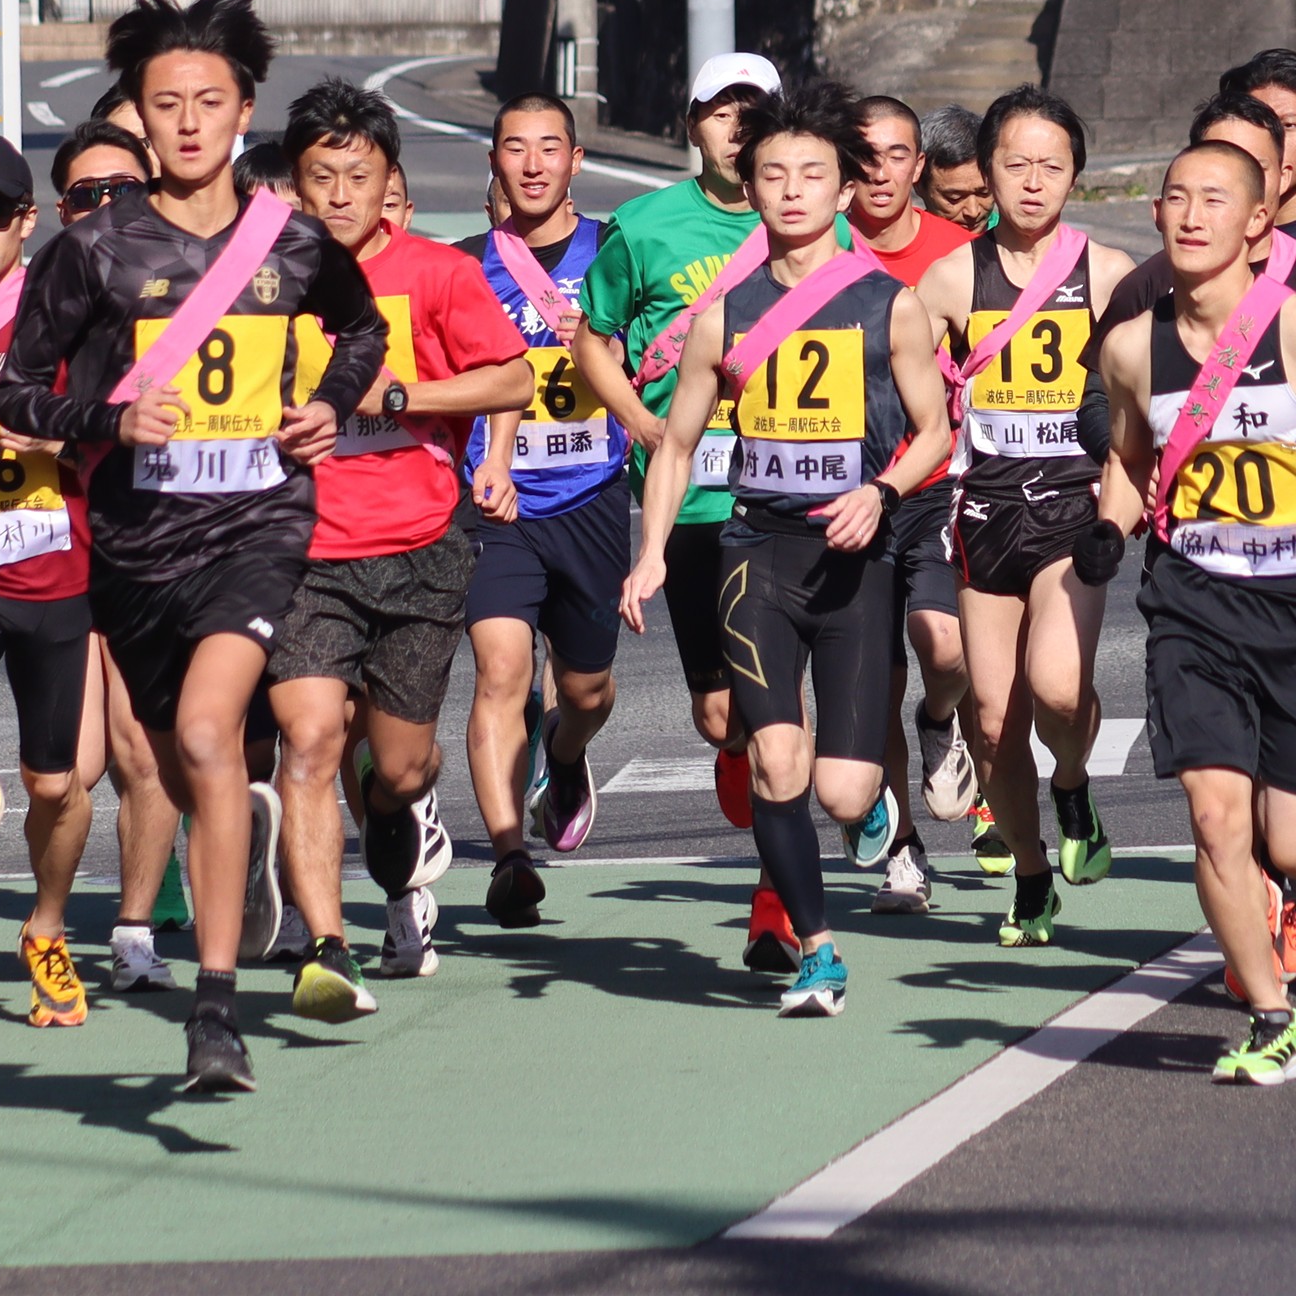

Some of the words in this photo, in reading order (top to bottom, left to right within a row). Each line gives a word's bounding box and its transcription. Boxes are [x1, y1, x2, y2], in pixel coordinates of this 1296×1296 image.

[993, 318, 1063, 384] 13
[197, 327, 235, 405] 8
[766, 340, 830, 410] 12
[986, 388, 1076, 405] 波佐見一周駅伝大会
[754, 416, 842, 434] 波佐見一周駅伝大会
[1036, 420, 1079, 445] 松尾
[547, 430, 593, 457] 田添
[795, 454, 848, 481] 中尾
[1192, 450, 1275, 521] 20
